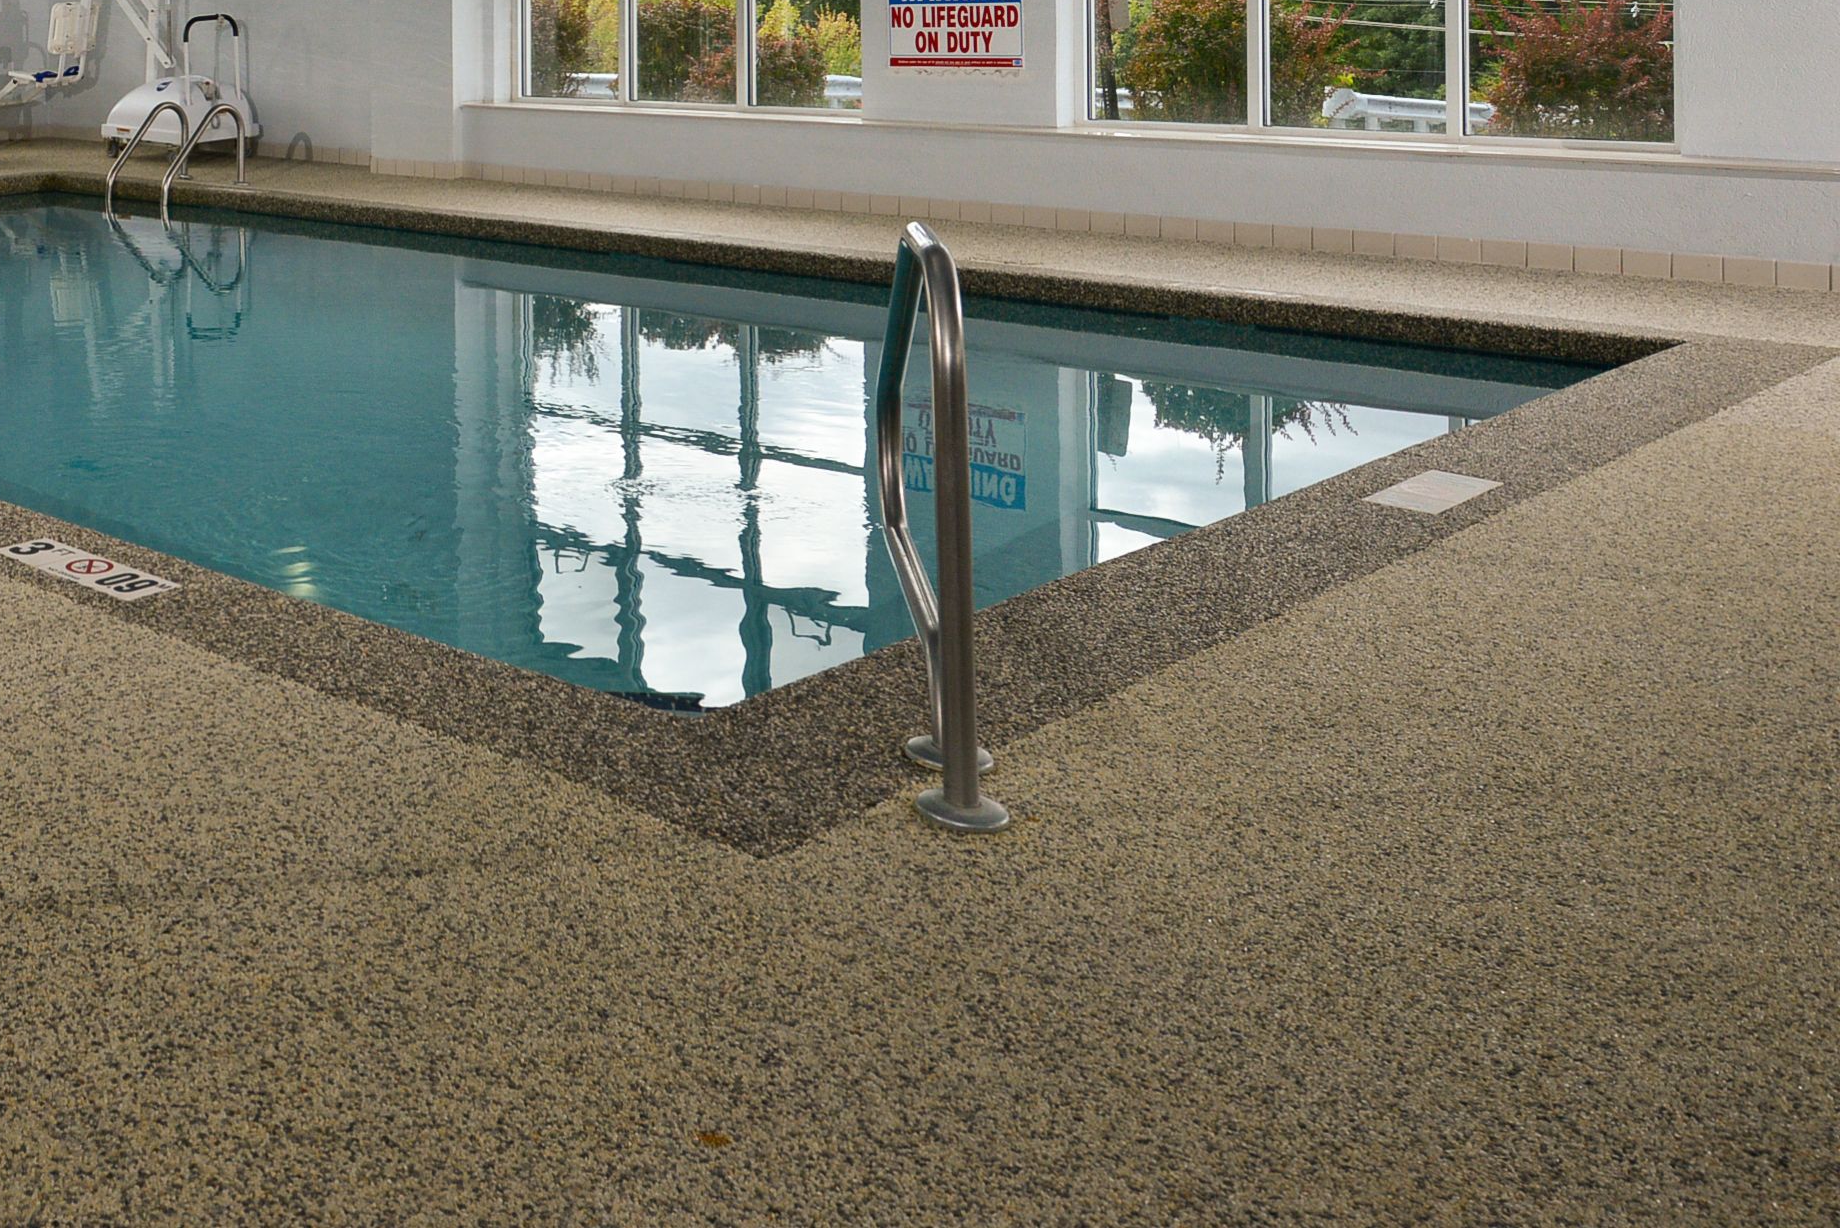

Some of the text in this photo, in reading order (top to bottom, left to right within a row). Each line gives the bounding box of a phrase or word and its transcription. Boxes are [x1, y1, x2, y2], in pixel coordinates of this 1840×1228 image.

[891, 5, 1019, 28] NO LIFEGUARD
[915, 30, 993, 53] ON DUTY
[9, 542, 55, 555] 3
